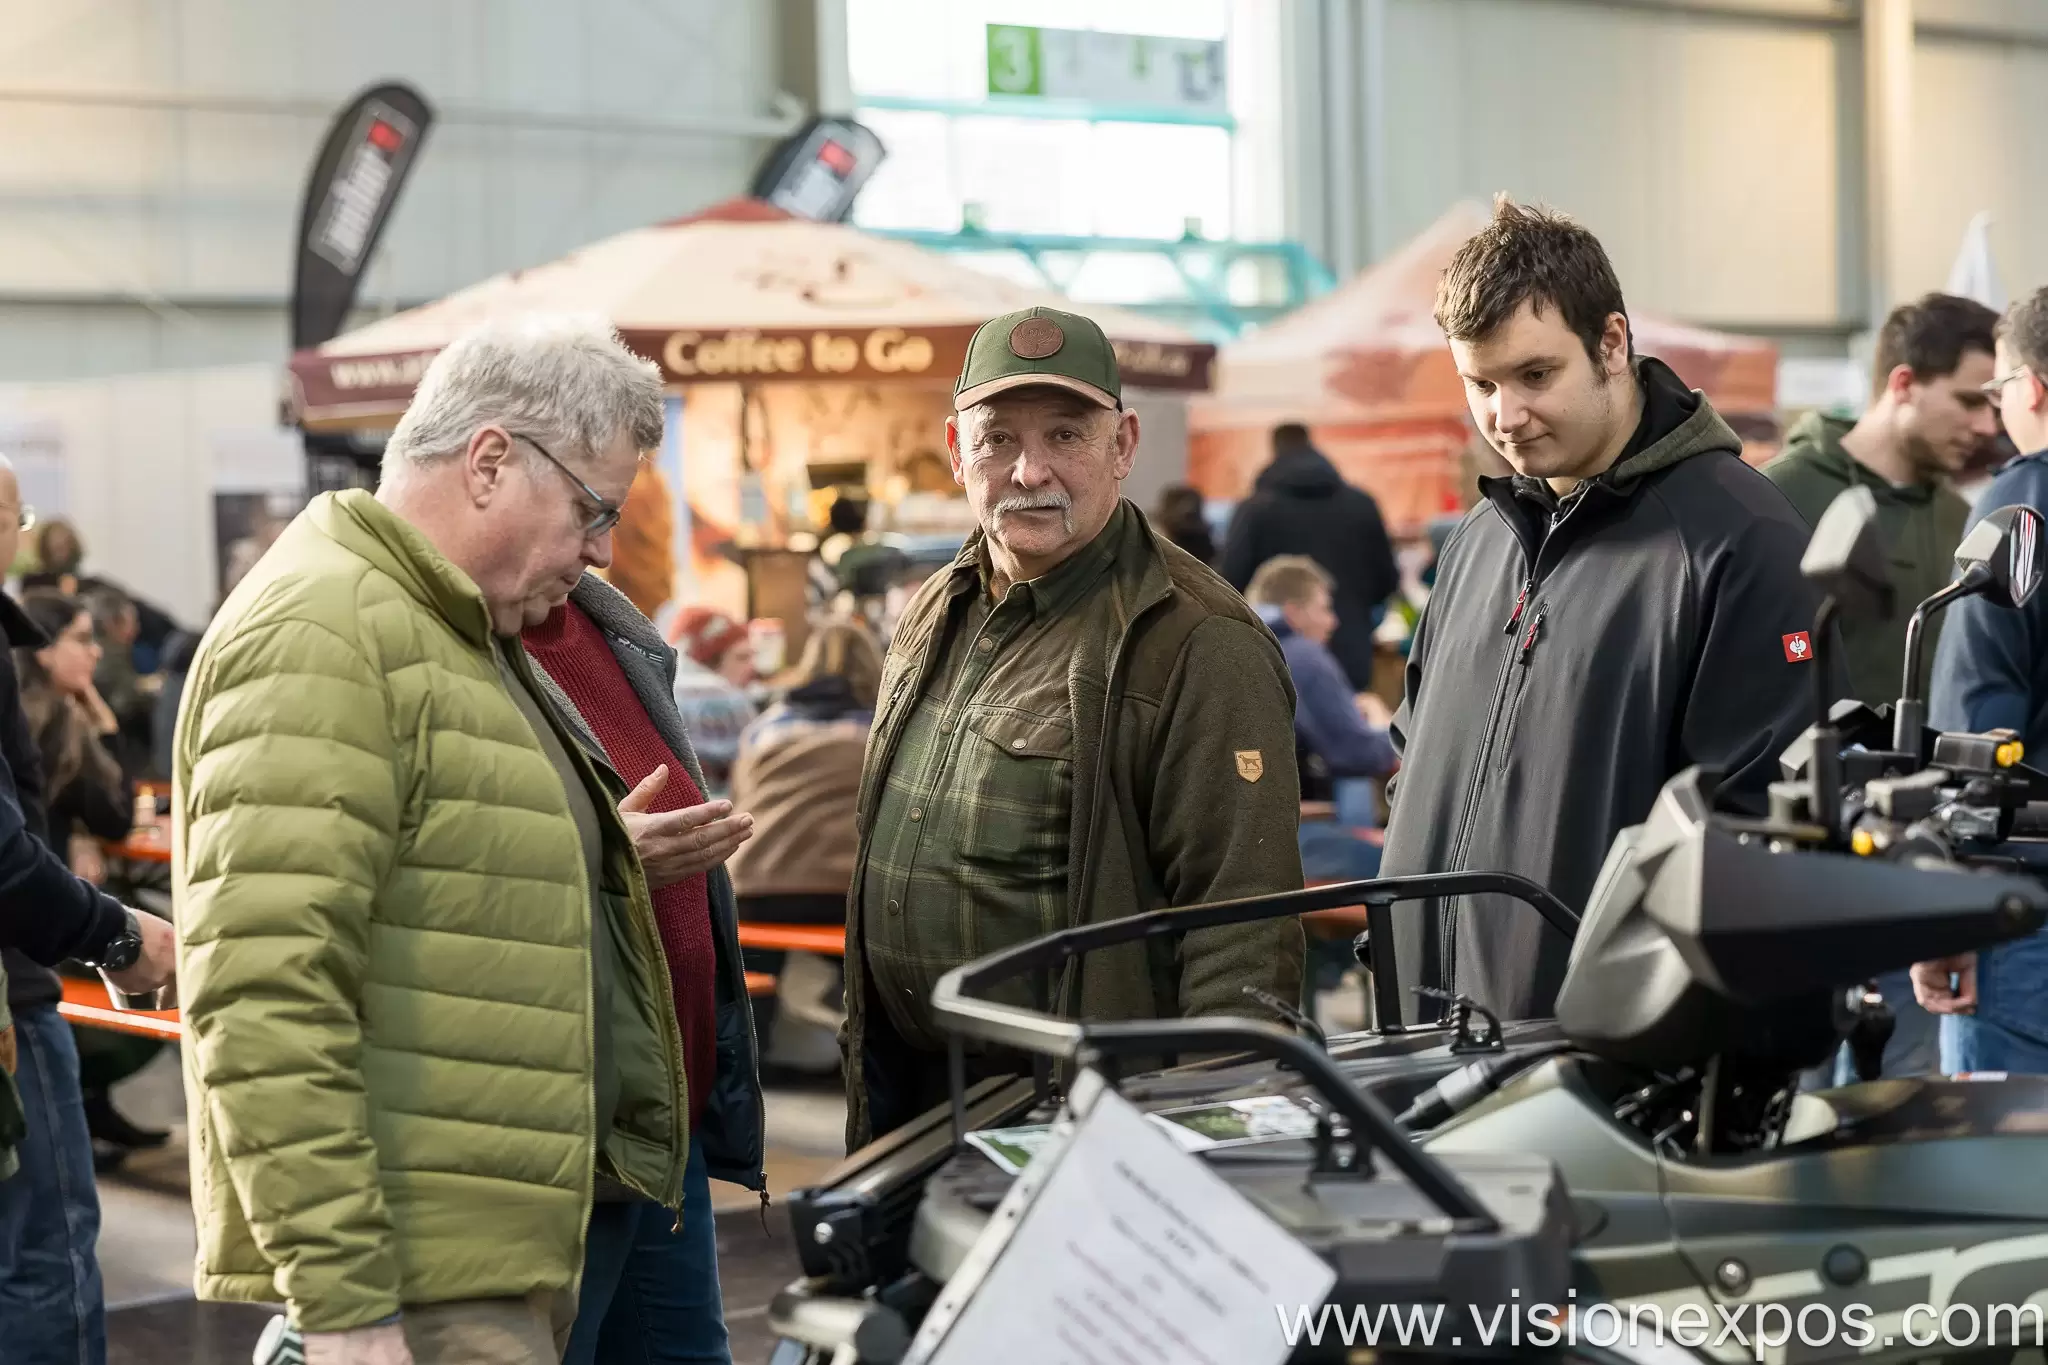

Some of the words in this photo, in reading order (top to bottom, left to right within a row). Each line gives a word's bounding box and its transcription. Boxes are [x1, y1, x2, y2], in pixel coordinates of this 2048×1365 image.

[991, 26, 1033, 92] 3
[663, 329, 805, 375] Coffee
[811, 330, 859, 373] to
[864, 326, 934, 373] Go
